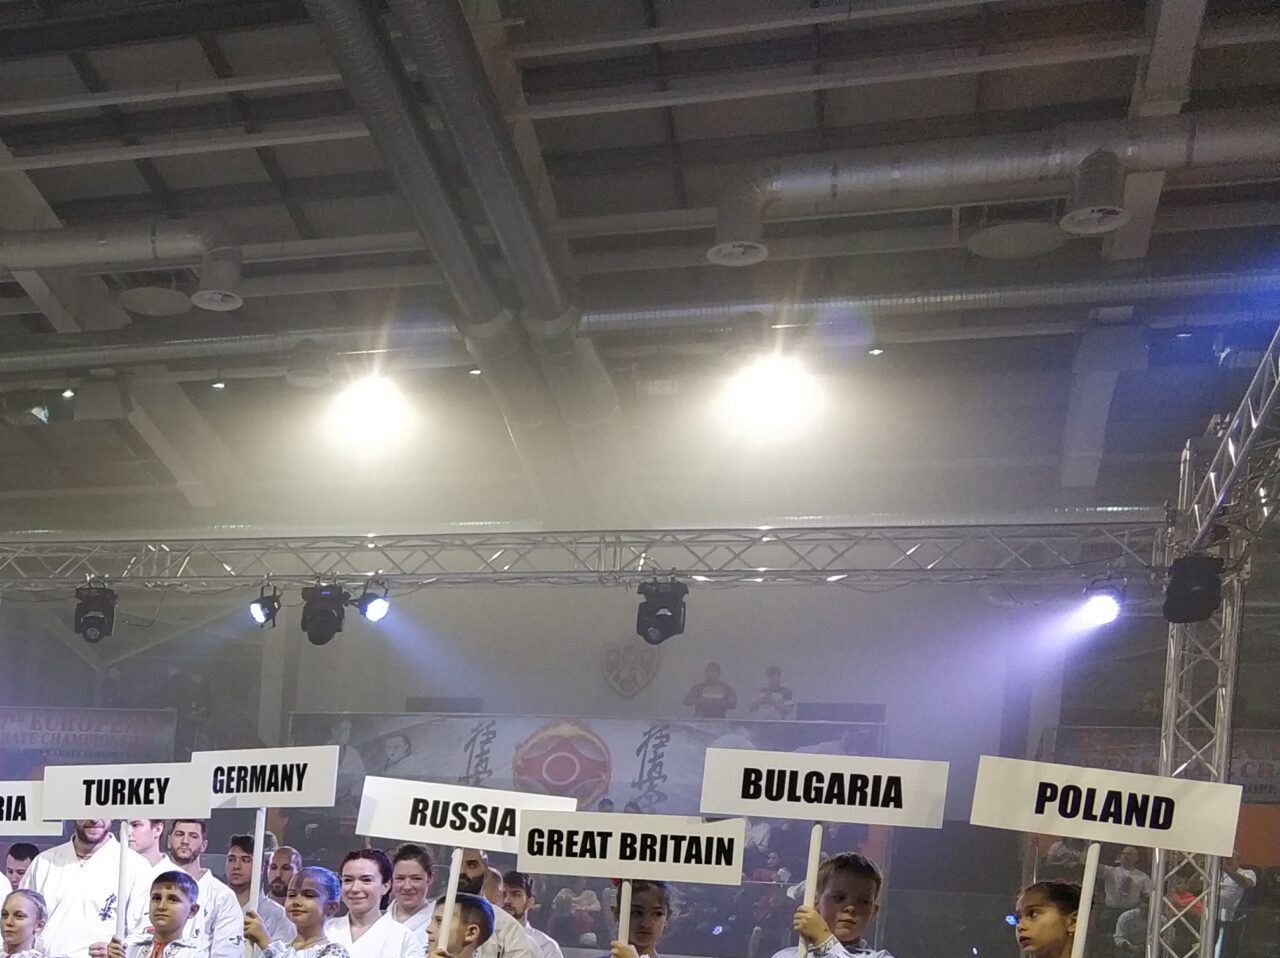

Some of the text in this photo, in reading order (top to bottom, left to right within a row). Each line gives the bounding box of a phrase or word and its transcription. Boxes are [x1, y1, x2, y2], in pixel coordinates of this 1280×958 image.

[83, 778, 170, 806] TURKEY
[212, 763, 308, 794] GERMANY
[741, 768, 903, 809] BULGARIA
[409, 799, 517, 837] RUSSIA
[1034, 781, 1176, 831] POLAND
[526, 827, 735, 866] GREAT BRITAIN
